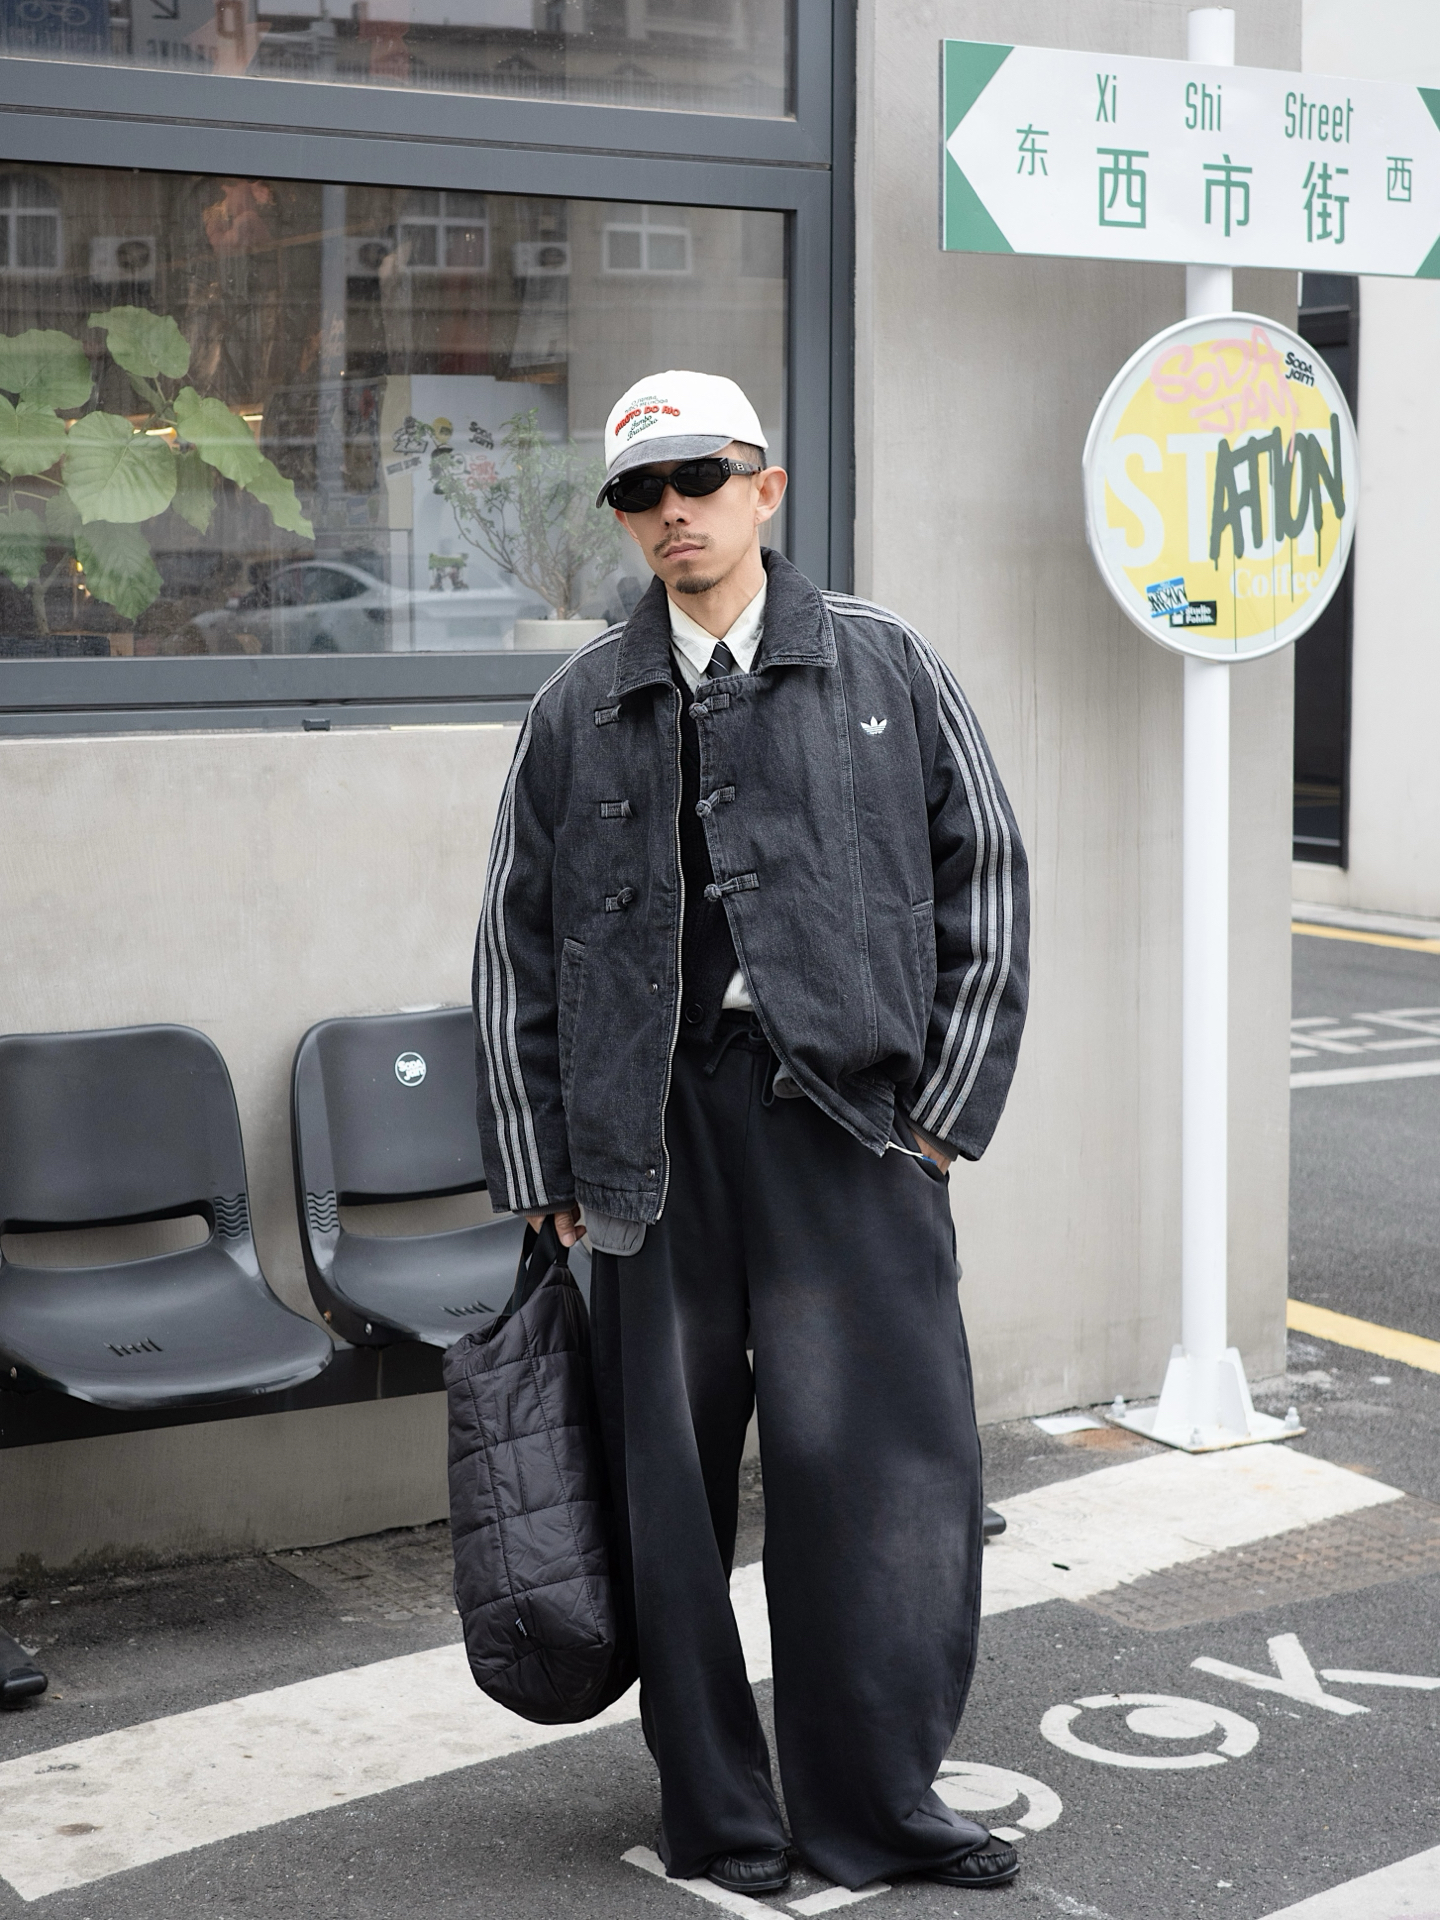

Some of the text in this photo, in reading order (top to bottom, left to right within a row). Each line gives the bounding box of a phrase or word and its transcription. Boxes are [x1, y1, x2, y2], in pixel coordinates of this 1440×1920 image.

[1095, 73, 1354, 144] Xi Shi Street
[1016, 123, 1050, 177] 东
[1386, 156, 1414, 203] 西
[1096, 147, 1350, 244] 西市街
